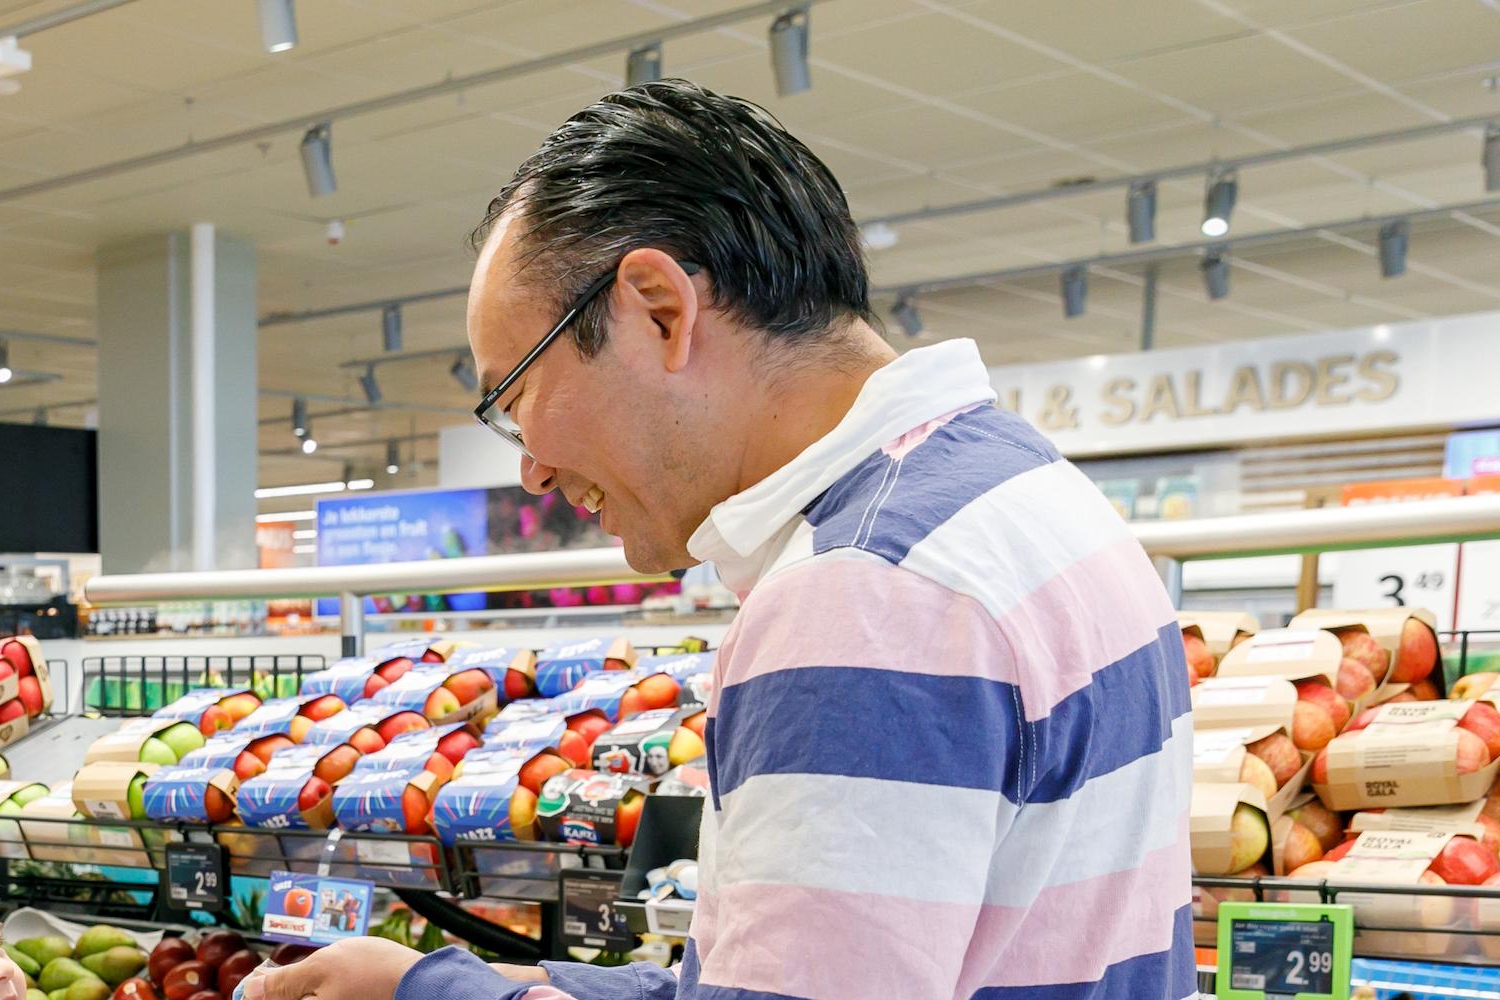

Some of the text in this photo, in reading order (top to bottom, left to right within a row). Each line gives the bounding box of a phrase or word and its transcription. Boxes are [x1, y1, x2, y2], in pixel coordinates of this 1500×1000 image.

[1100, 350, 1400, 426] SALADES
[1365, 780, 1400, 790] ROYAL
[1367, 787, 1397, 797] GALA
